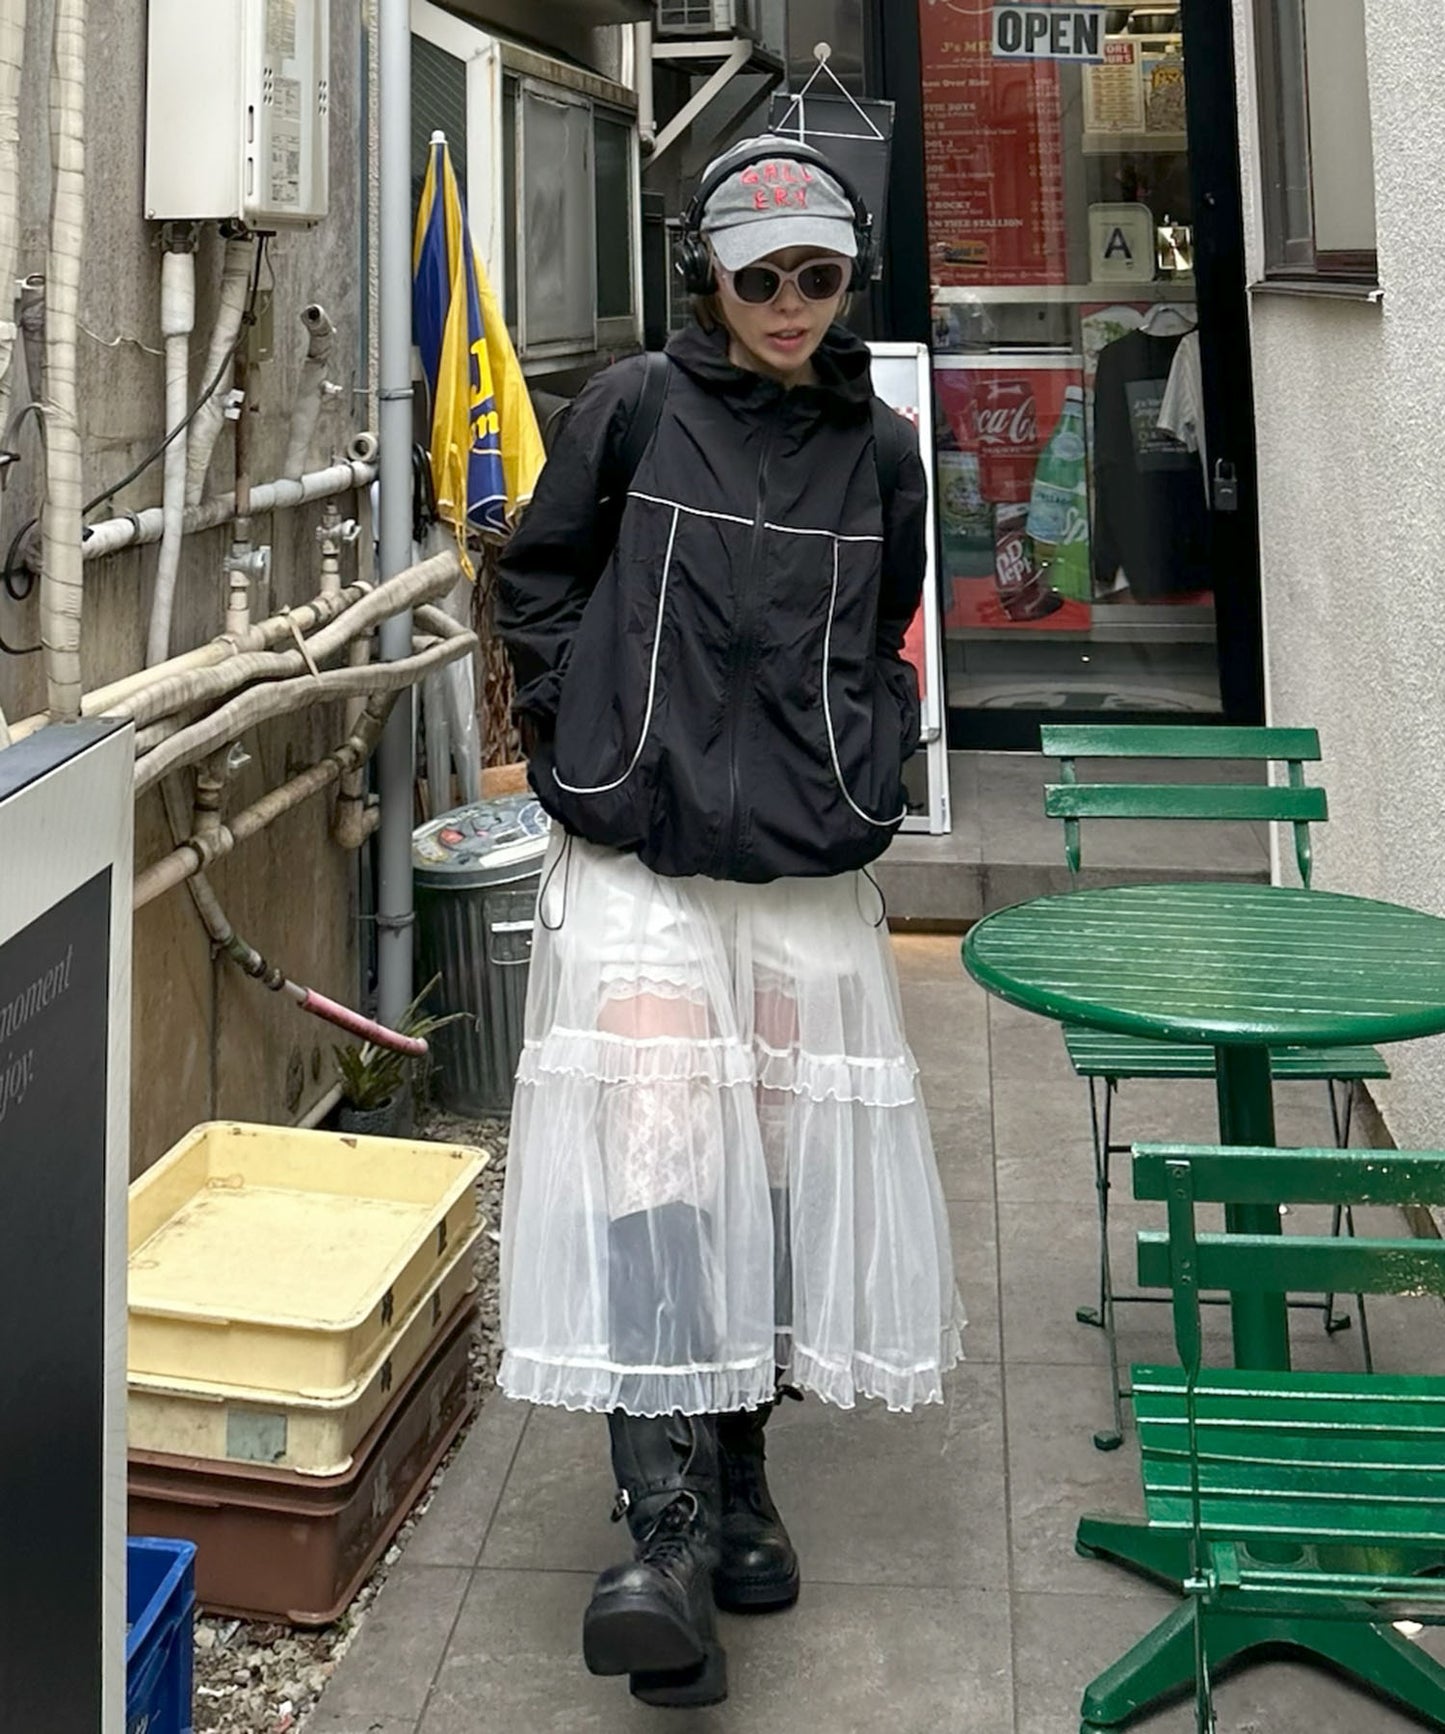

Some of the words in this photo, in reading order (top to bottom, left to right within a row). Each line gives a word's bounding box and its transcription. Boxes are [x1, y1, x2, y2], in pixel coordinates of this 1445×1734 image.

[997, 10, 1098, 55] OPEN
[739, 163, 814, 185] GALL
[754, 186, 808, 211] ERY
[935, 201, 972, 209] ROCKY
[972, 218, 1024, 228] STALLION
[1104, 227, 1133, 260] A
